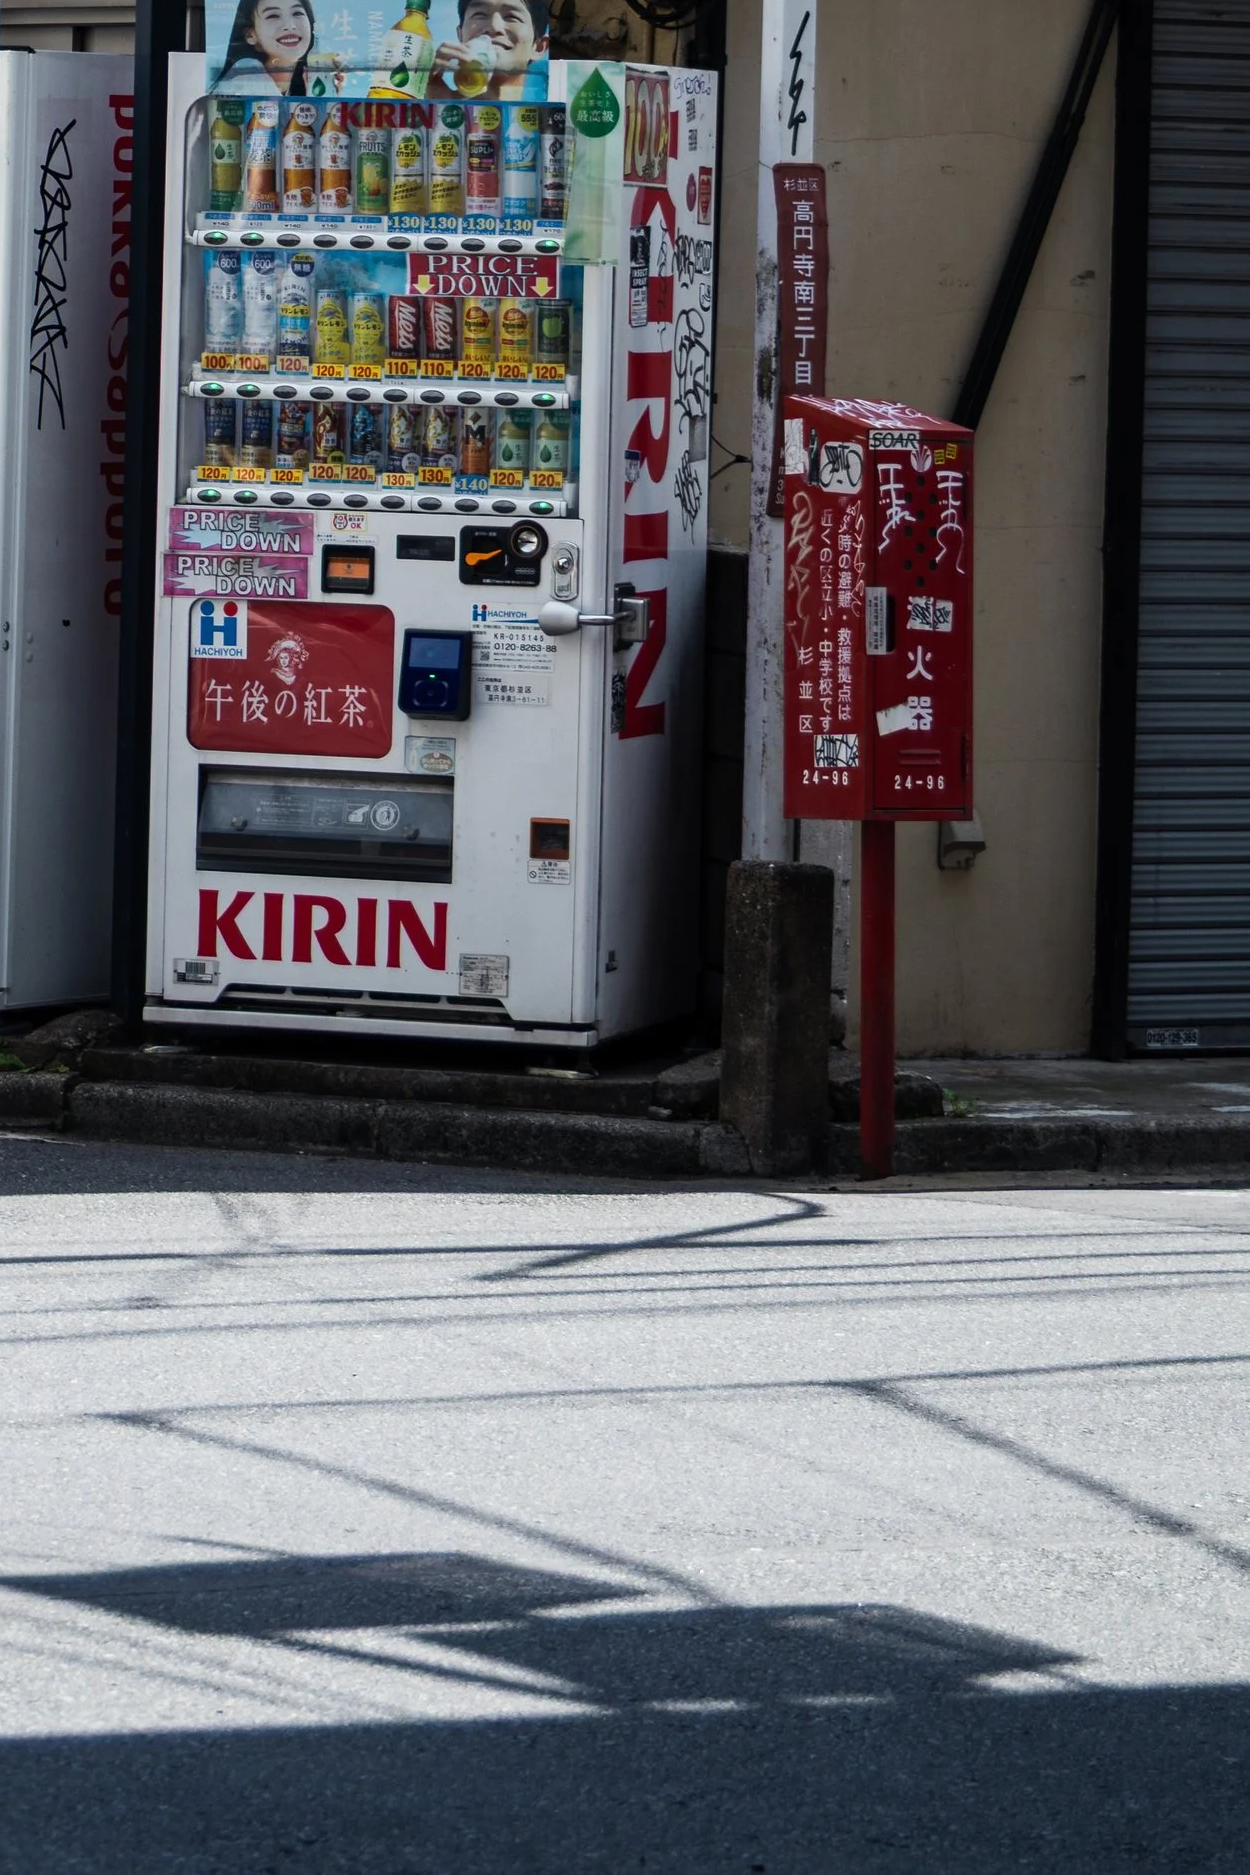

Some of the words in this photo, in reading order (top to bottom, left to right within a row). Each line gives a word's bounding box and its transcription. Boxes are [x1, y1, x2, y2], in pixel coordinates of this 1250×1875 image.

[339, 101, 434, 129] KIRIN
[576, 109, 614, 123] 最高級
[359, 142, 386, 152] FRUITS
[783, 178, 819, 192] 杉並区
[387, 217, 420, 229] ¥130
[424, 217, 457, 229] ¥130
[462, 218, 495, 230] ¥130
[500, 219, 532, 231] ¥130
[220, 258, 237, 268] 600
[254, 259, 271, 269] 600
[426, 255, 538, 276] PRICE
[284, 284, 306, 293] KIRIN
[436, 275, 527, 297] DOWN
[792, 200, 816, 385] 高円寺南三丁目
[280, 307, 310, 315] キリンレモン
[398, 300, 416, 350] Mets
[434, 301, 453, 351] Mets
[204, 355, 234, 369] 100円
[238, 356, 267, 370] 100円
[279, 358, 307, 371] 120円
[386, 361, 415, 375] 110円
[423, 362, 451, 375] 110円
[316, 364, 342, 376] 120円
[352, 366, 378, 378] 120円
[460, 363, 489, 376] 120円
[497, 364, 526, 378] 120円
[534, 365, 563, 379] 120円
[869, 432, 918, 450] SOAR
[201, 467, 227, 479] 120円
[236, 468, 262, 480] 120円
[274, 470, 300, 481] 120円
[311, 465, 340, 479] 120円
[345, 466, 373, 480] 120円
[421, 469, 450, 483] 130円
[492, 472, 521, 485] 120円
[386, 474, 412, 486] 130円
[455, 478, 487, 491] ¥140
[531, 473, 561, 487] 120円
[183, 511, 260, 532] PRICE
[221, 531, 301, 553] DOWN
[177, 556, 254, 576] PRICE
[215, 576, 296, 597] DOWN
[818, 508, 833, 733] 近くの区立小・中学校です
[493, 633, 544, 642] KR-015145
[194, 647, 244, 657] HACHIYOH
[493, 643, 557, 653] 0120-8263-88
[484, 684, 532, 694] 東京都杉並区
[798, 646, 814, 733] 杉並区
[204, 679, 368, 728] 午後の紅茶
[802, 769, 849, 786] 24-96
[894, 775, 945, 790] 24-96
[197, 889, 448, 972] KIRIN
